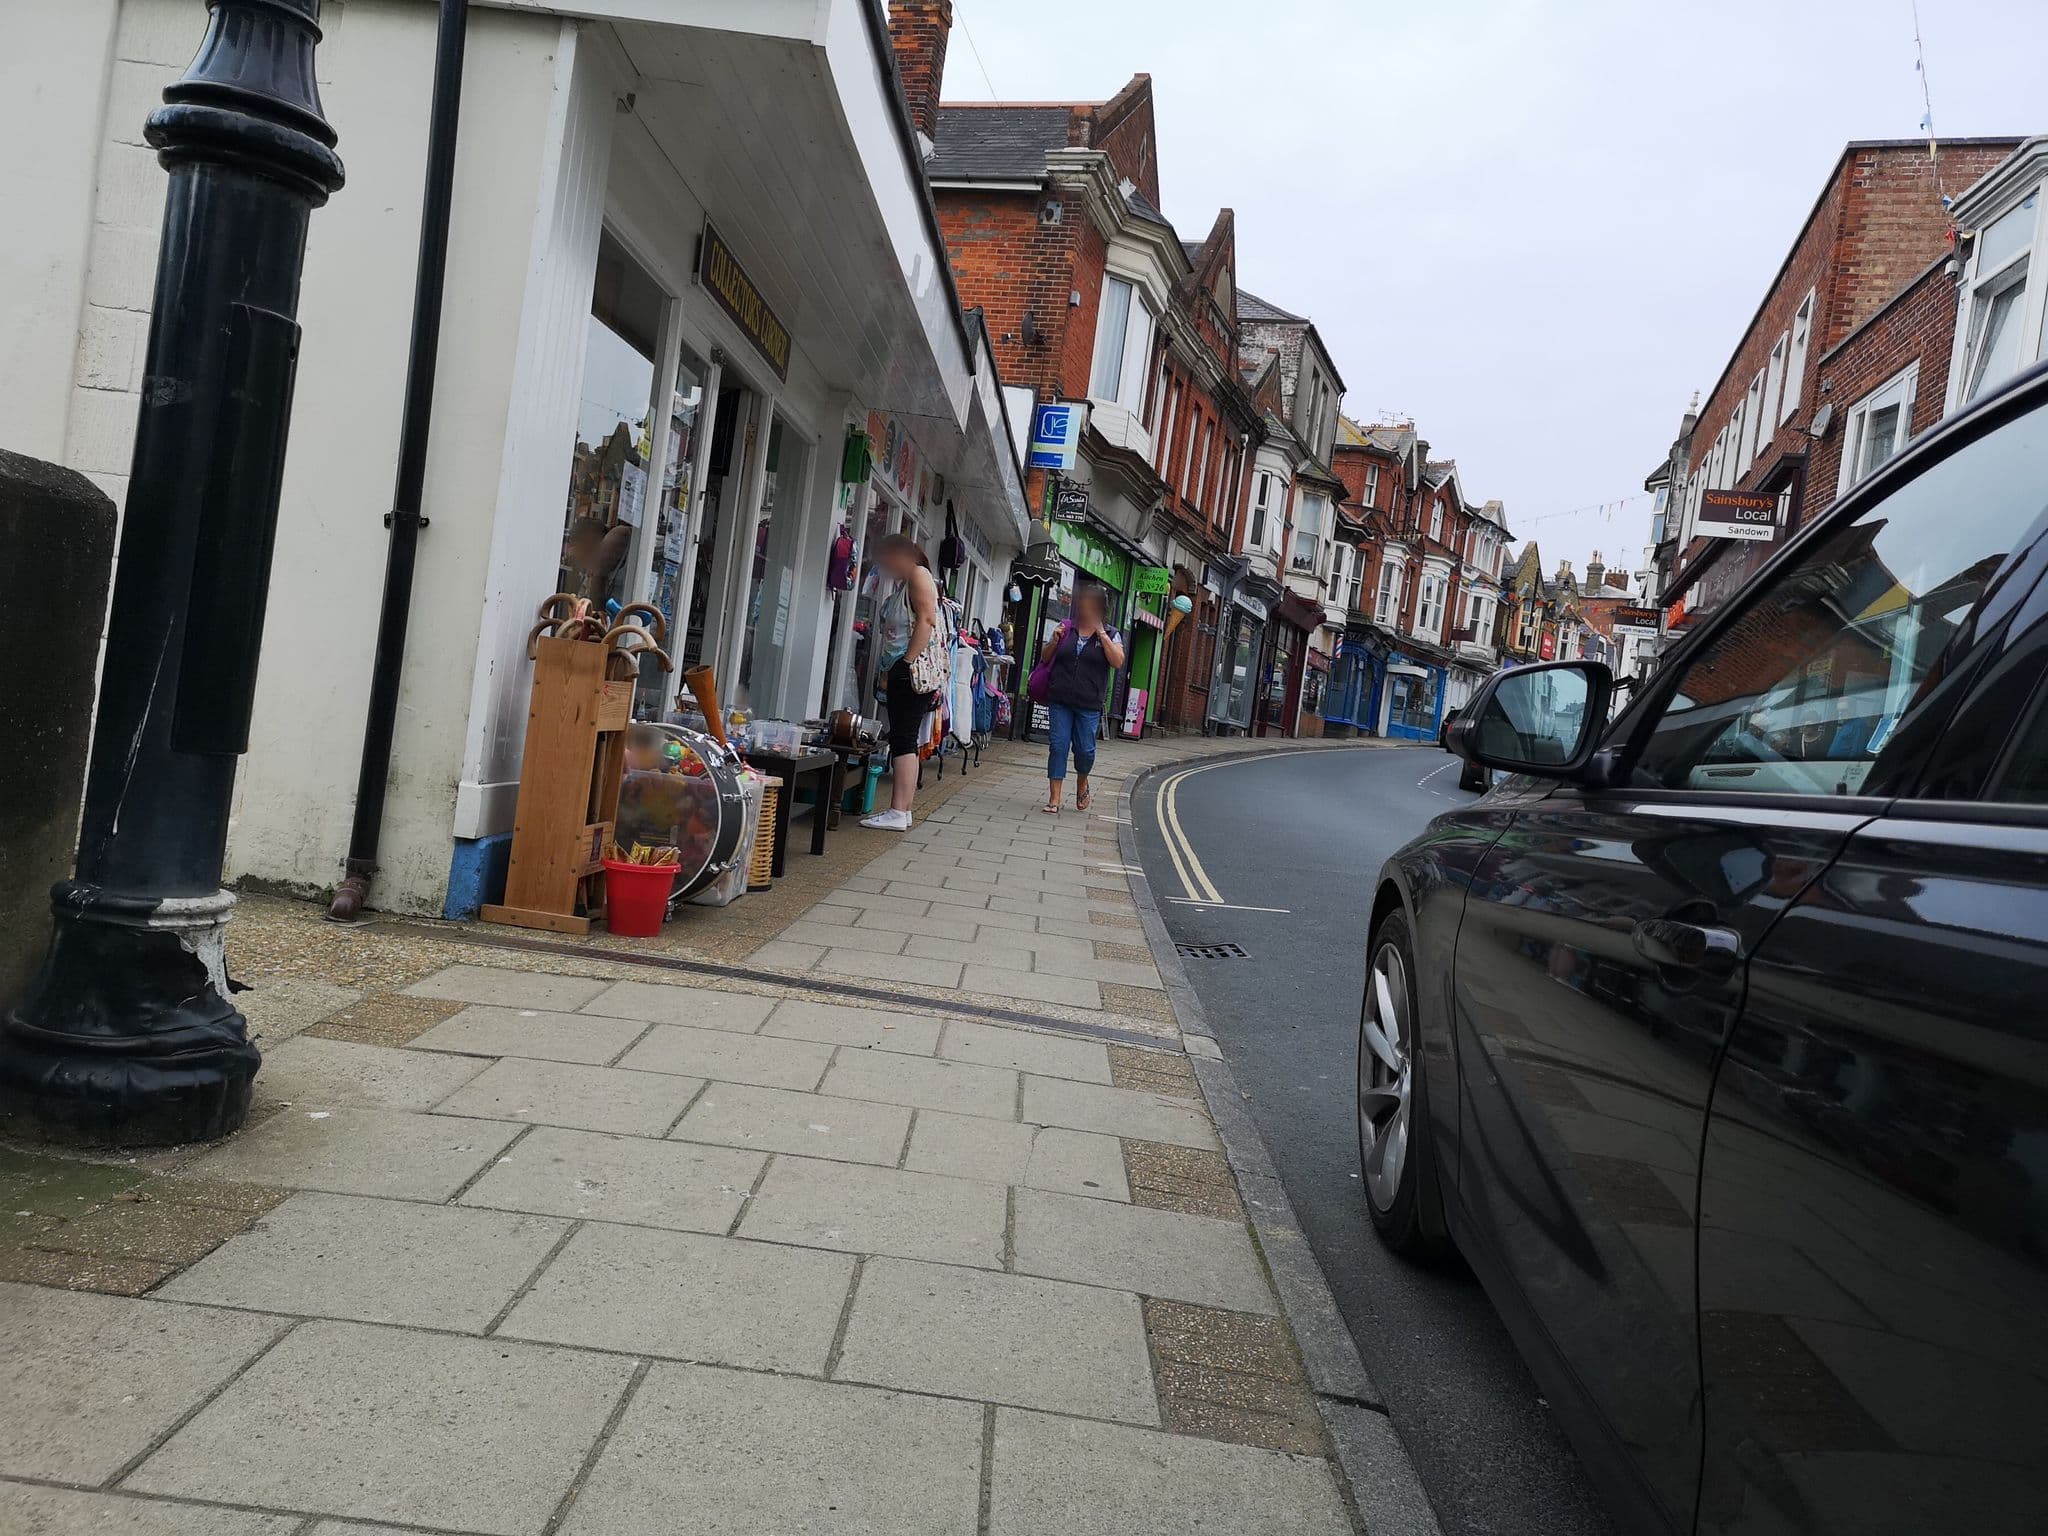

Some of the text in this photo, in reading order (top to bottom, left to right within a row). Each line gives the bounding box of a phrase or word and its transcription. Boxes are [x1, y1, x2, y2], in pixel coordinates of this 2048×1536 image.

[710, 240, 786, 369] COLLECTORS CORNER
[1705, 493, 1774, 509] Sainsbury's
[1735, 507, 1772, 522] Local
[1727, 526, 1770, 537] Sandown
[1139, 573, 1164, 582] Kitchen
[1635, 617, 1657, 626] Local
